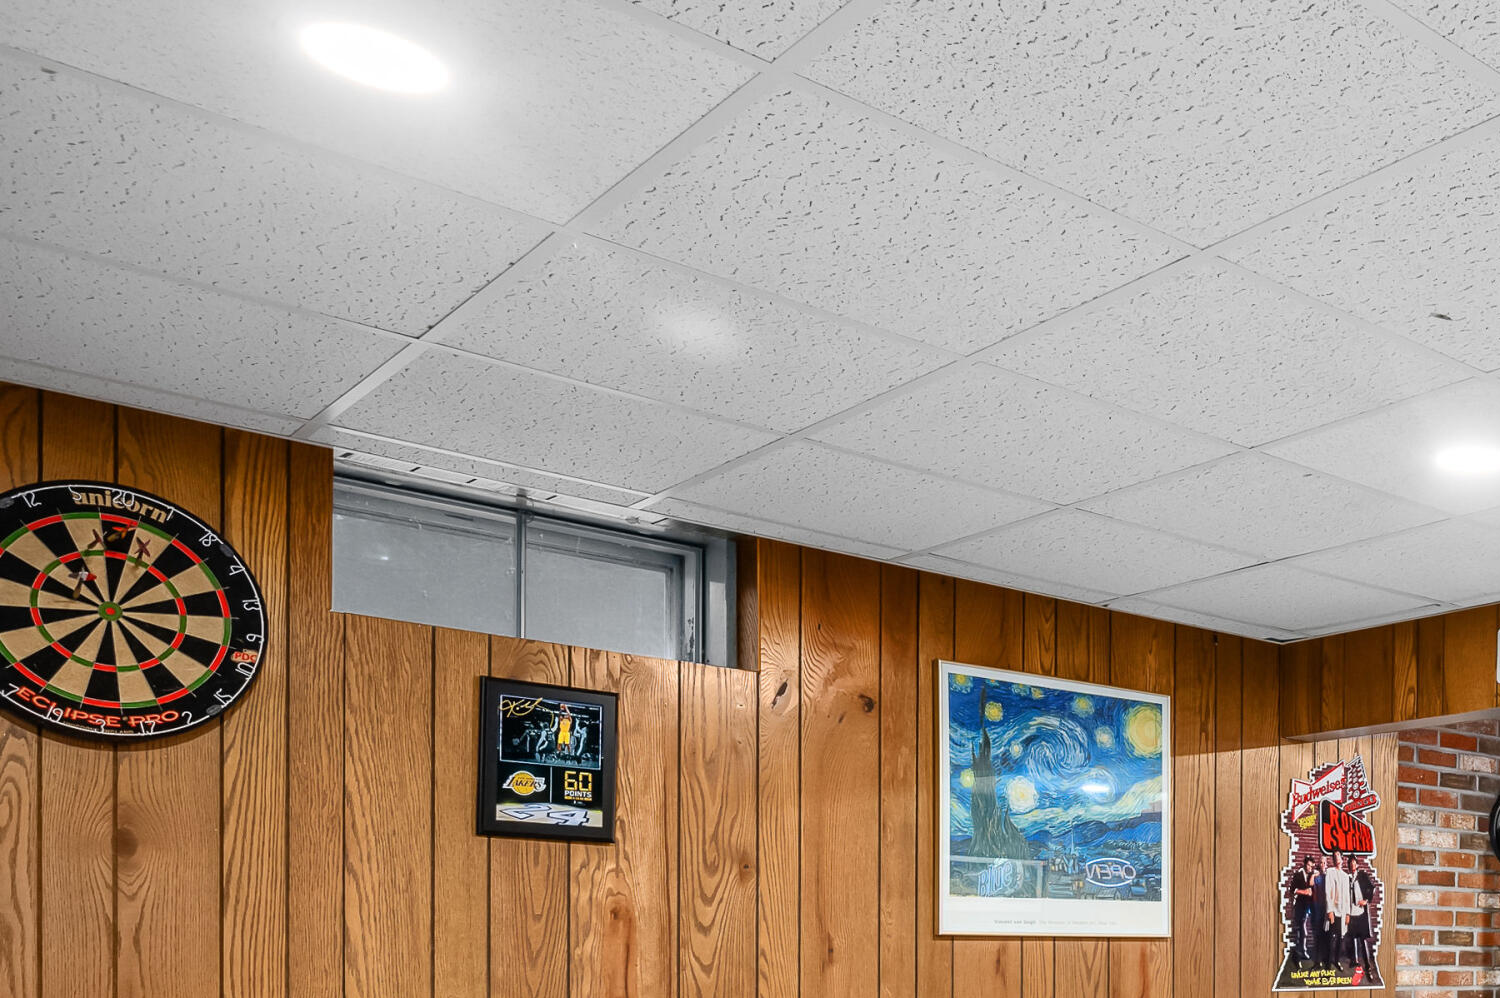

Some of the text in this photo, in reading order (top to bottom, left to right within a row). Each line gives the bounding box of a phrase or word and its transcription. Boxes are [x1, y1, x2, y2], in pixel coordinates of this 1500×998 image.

[22, 492, 42, 508] 12
[112, 489, 135, 506] 20
[72, 490, 168, 523] unicorn
[199, 532, 217, 547] 18
[229, 565, 245, 575] 4
[242, 599, 261, 611] 13
[234, 651, 257, 662] PDC
[235, 662, 255, 679] 10
[213, 688, 233, 706] 15
[16, 686, 179, 727] ECLIPSE PRO
[181, 711, 193, 725] 2
[564, 770, 592, 791] 60
[564, 790, 592, 798] POINTS
[1292, 777, 1347, 808] Budweiser
